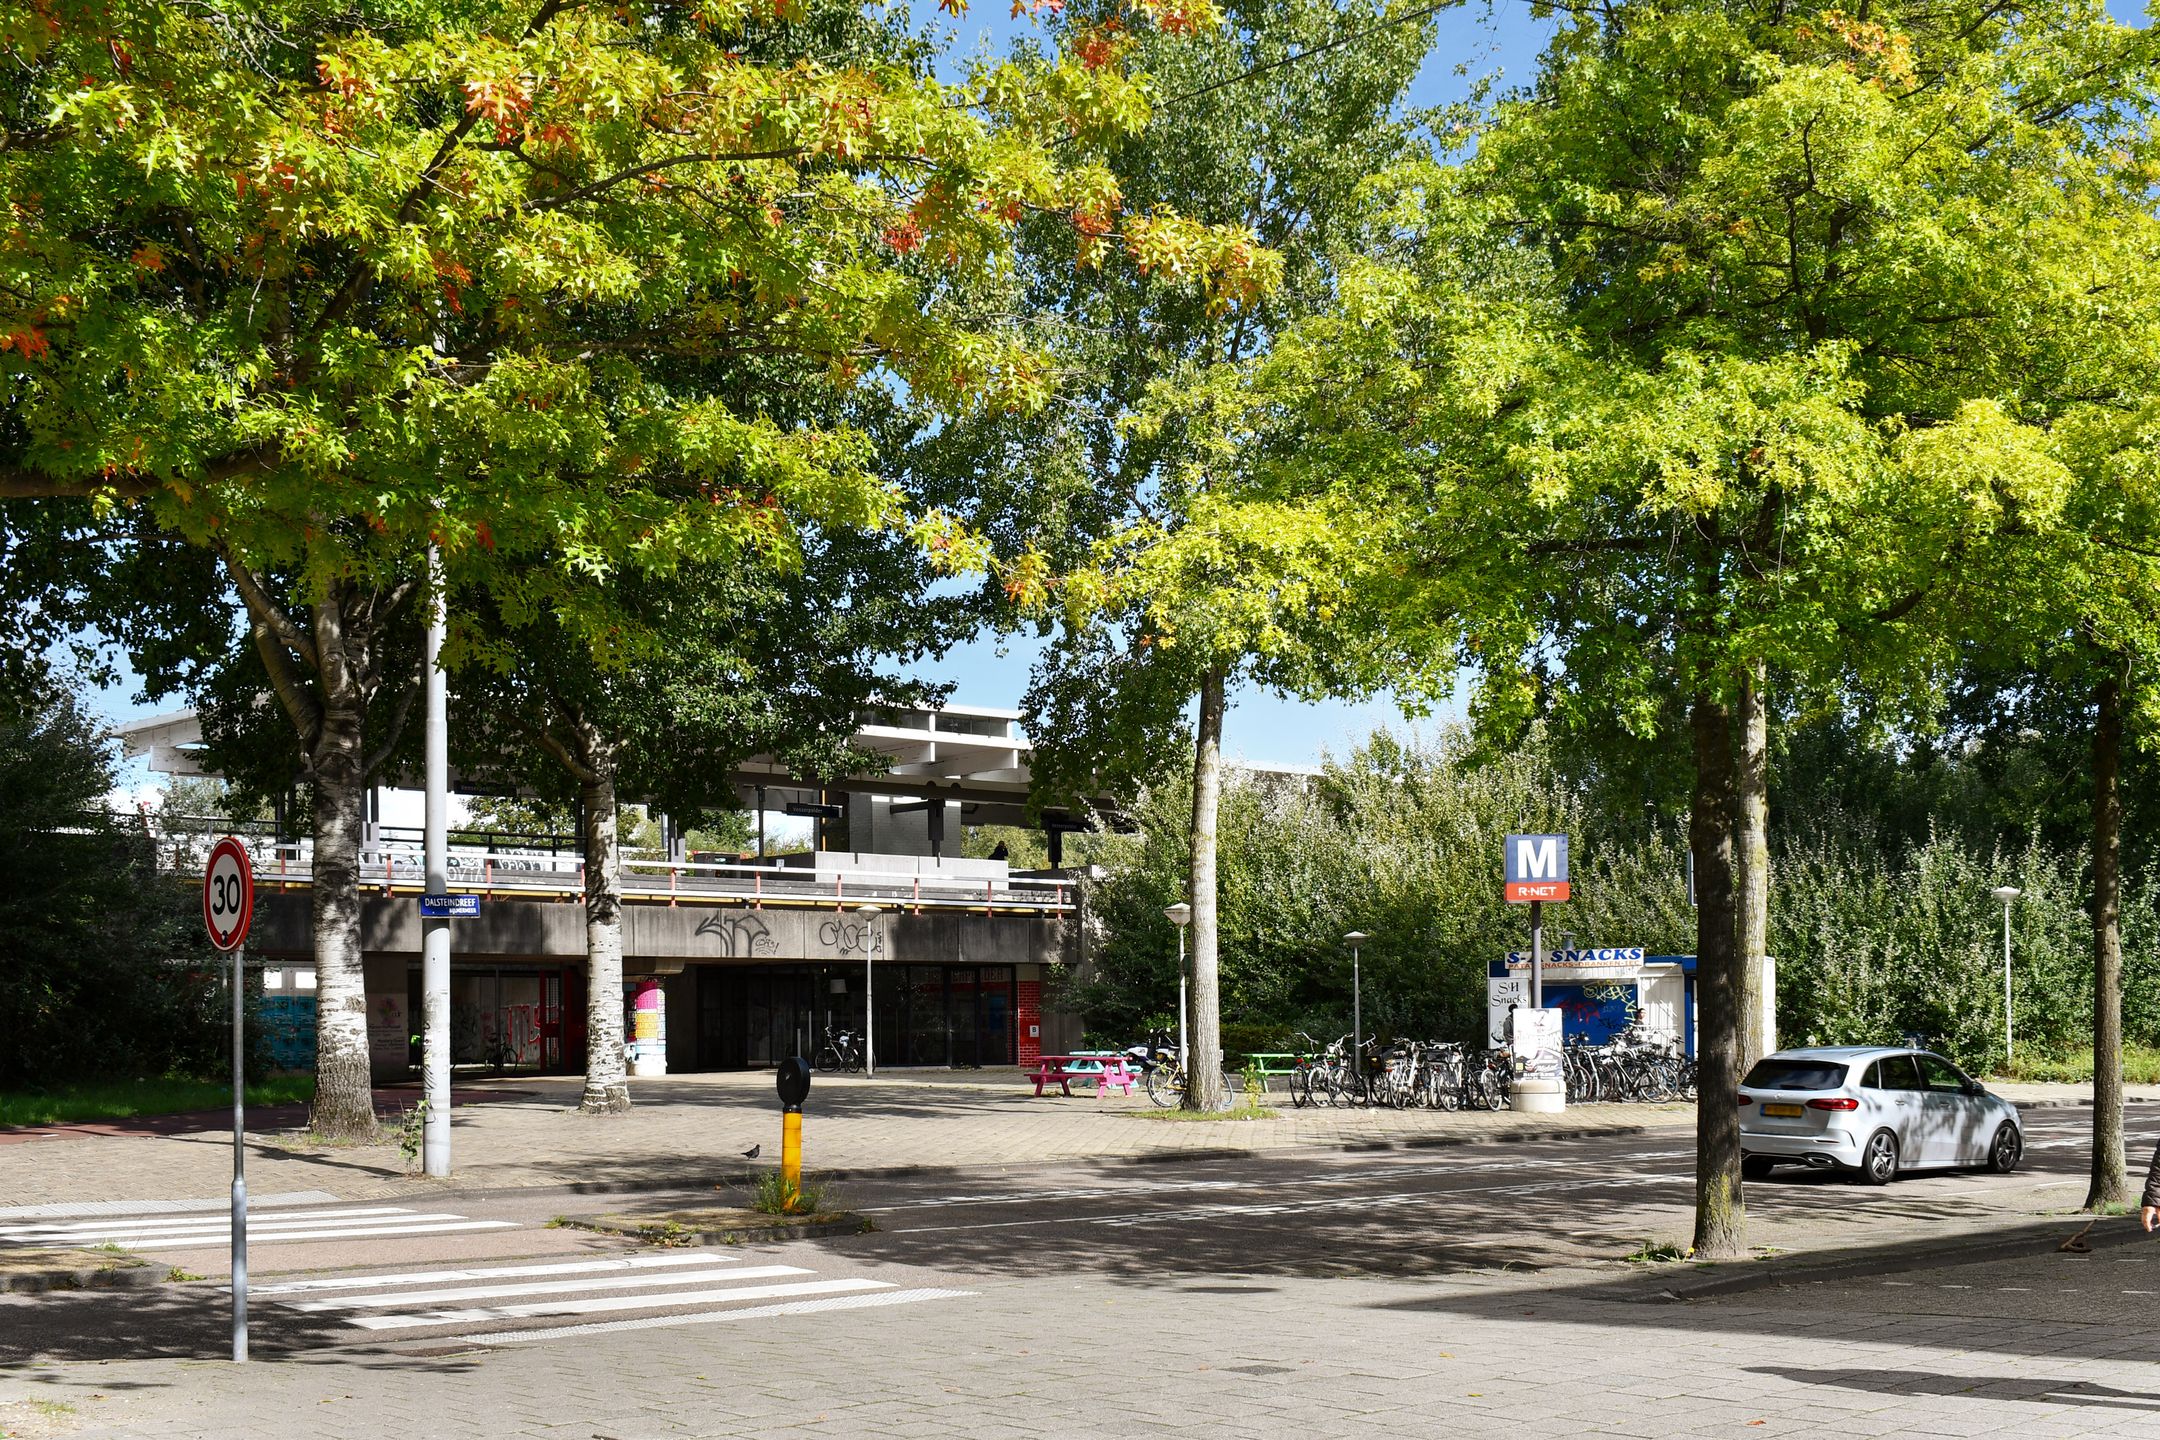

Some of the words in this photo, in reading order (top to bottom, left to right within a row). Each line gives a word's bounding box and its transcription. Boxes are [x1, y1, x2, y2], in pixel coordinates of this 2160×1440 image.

[1517, 839, 1557, 878] M
[212, 873, 241, 916] 30
[425, 898, 476, 907] DALSTEINDREEF
[1550, 948, 1642, 963] SNACKS
[1491, 994, 1527, 1007] Snacks
